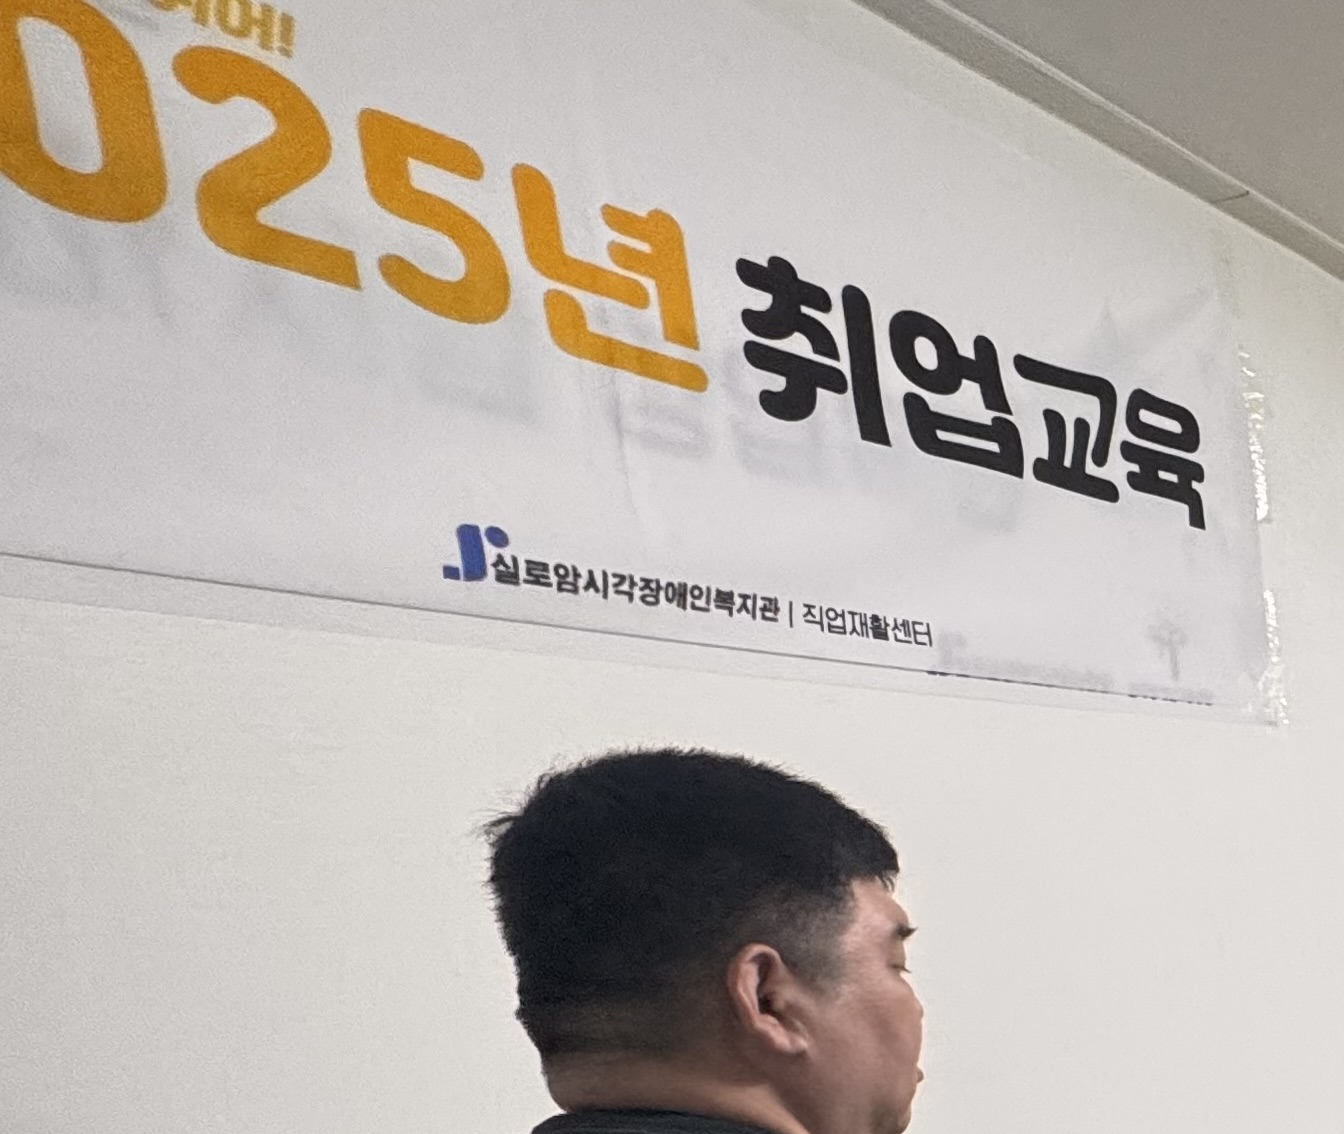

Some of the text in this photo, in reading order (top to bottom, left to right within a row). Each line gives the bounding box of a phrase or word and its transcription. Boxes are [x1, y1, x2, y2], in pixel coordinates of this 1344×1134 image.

[735, 255, 1207, 531] 취업교육
[491, 552, 934, 648] 실로암시각장애인복지관 직업재활센터
